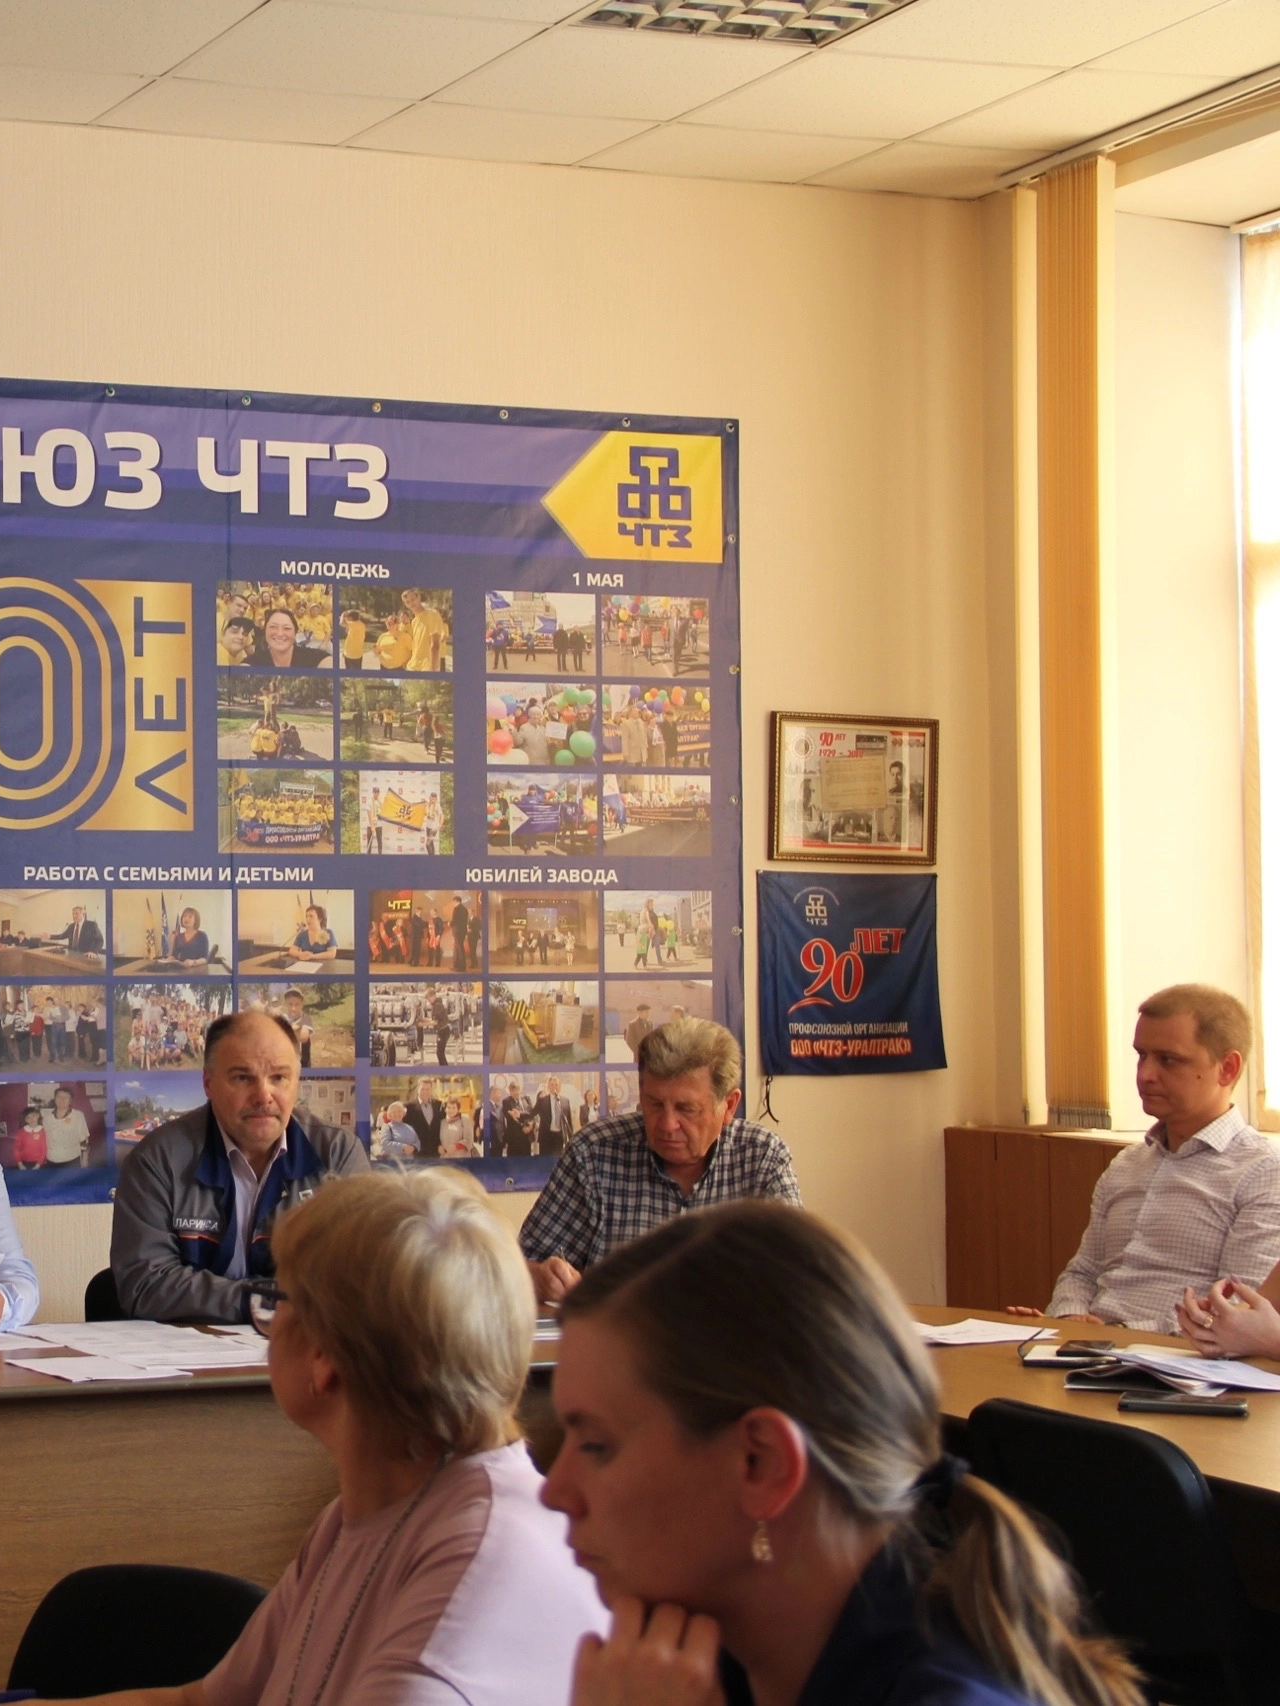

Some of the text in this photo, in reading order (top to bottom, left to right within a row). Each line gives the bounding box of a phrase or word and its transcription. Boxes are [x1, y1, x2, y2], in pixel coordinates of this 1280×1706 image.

[197, 436, 389, 520] ЧТЗ
[617, 522, 692, 548] ЧТЗ
[280, 560, 390, 580] МОЛОДЕЖЬ
[572, 572, 624, 587] 1 МАЯ
[133, 595, 188, 816] ЛЕТ
[23, 866, 314, 884] РАБОТА С СЕМЬЯМИ И ДЕТЬМИ
[465, 865, 619, 885] ЮБИЛЕЙ ЗАВОДА
[806, 917, 829, 926] ЧТЗ
[800, 927, 907, 1003] 90 ЛЕТ
[788, 1021, 909, 1036] ПРОФСОЮЗНОЙ ОРГАНИЗАЦИИ
[790, 1037, 913, 1056] ООО «ЧТЗ-УРАЛТРАК»
